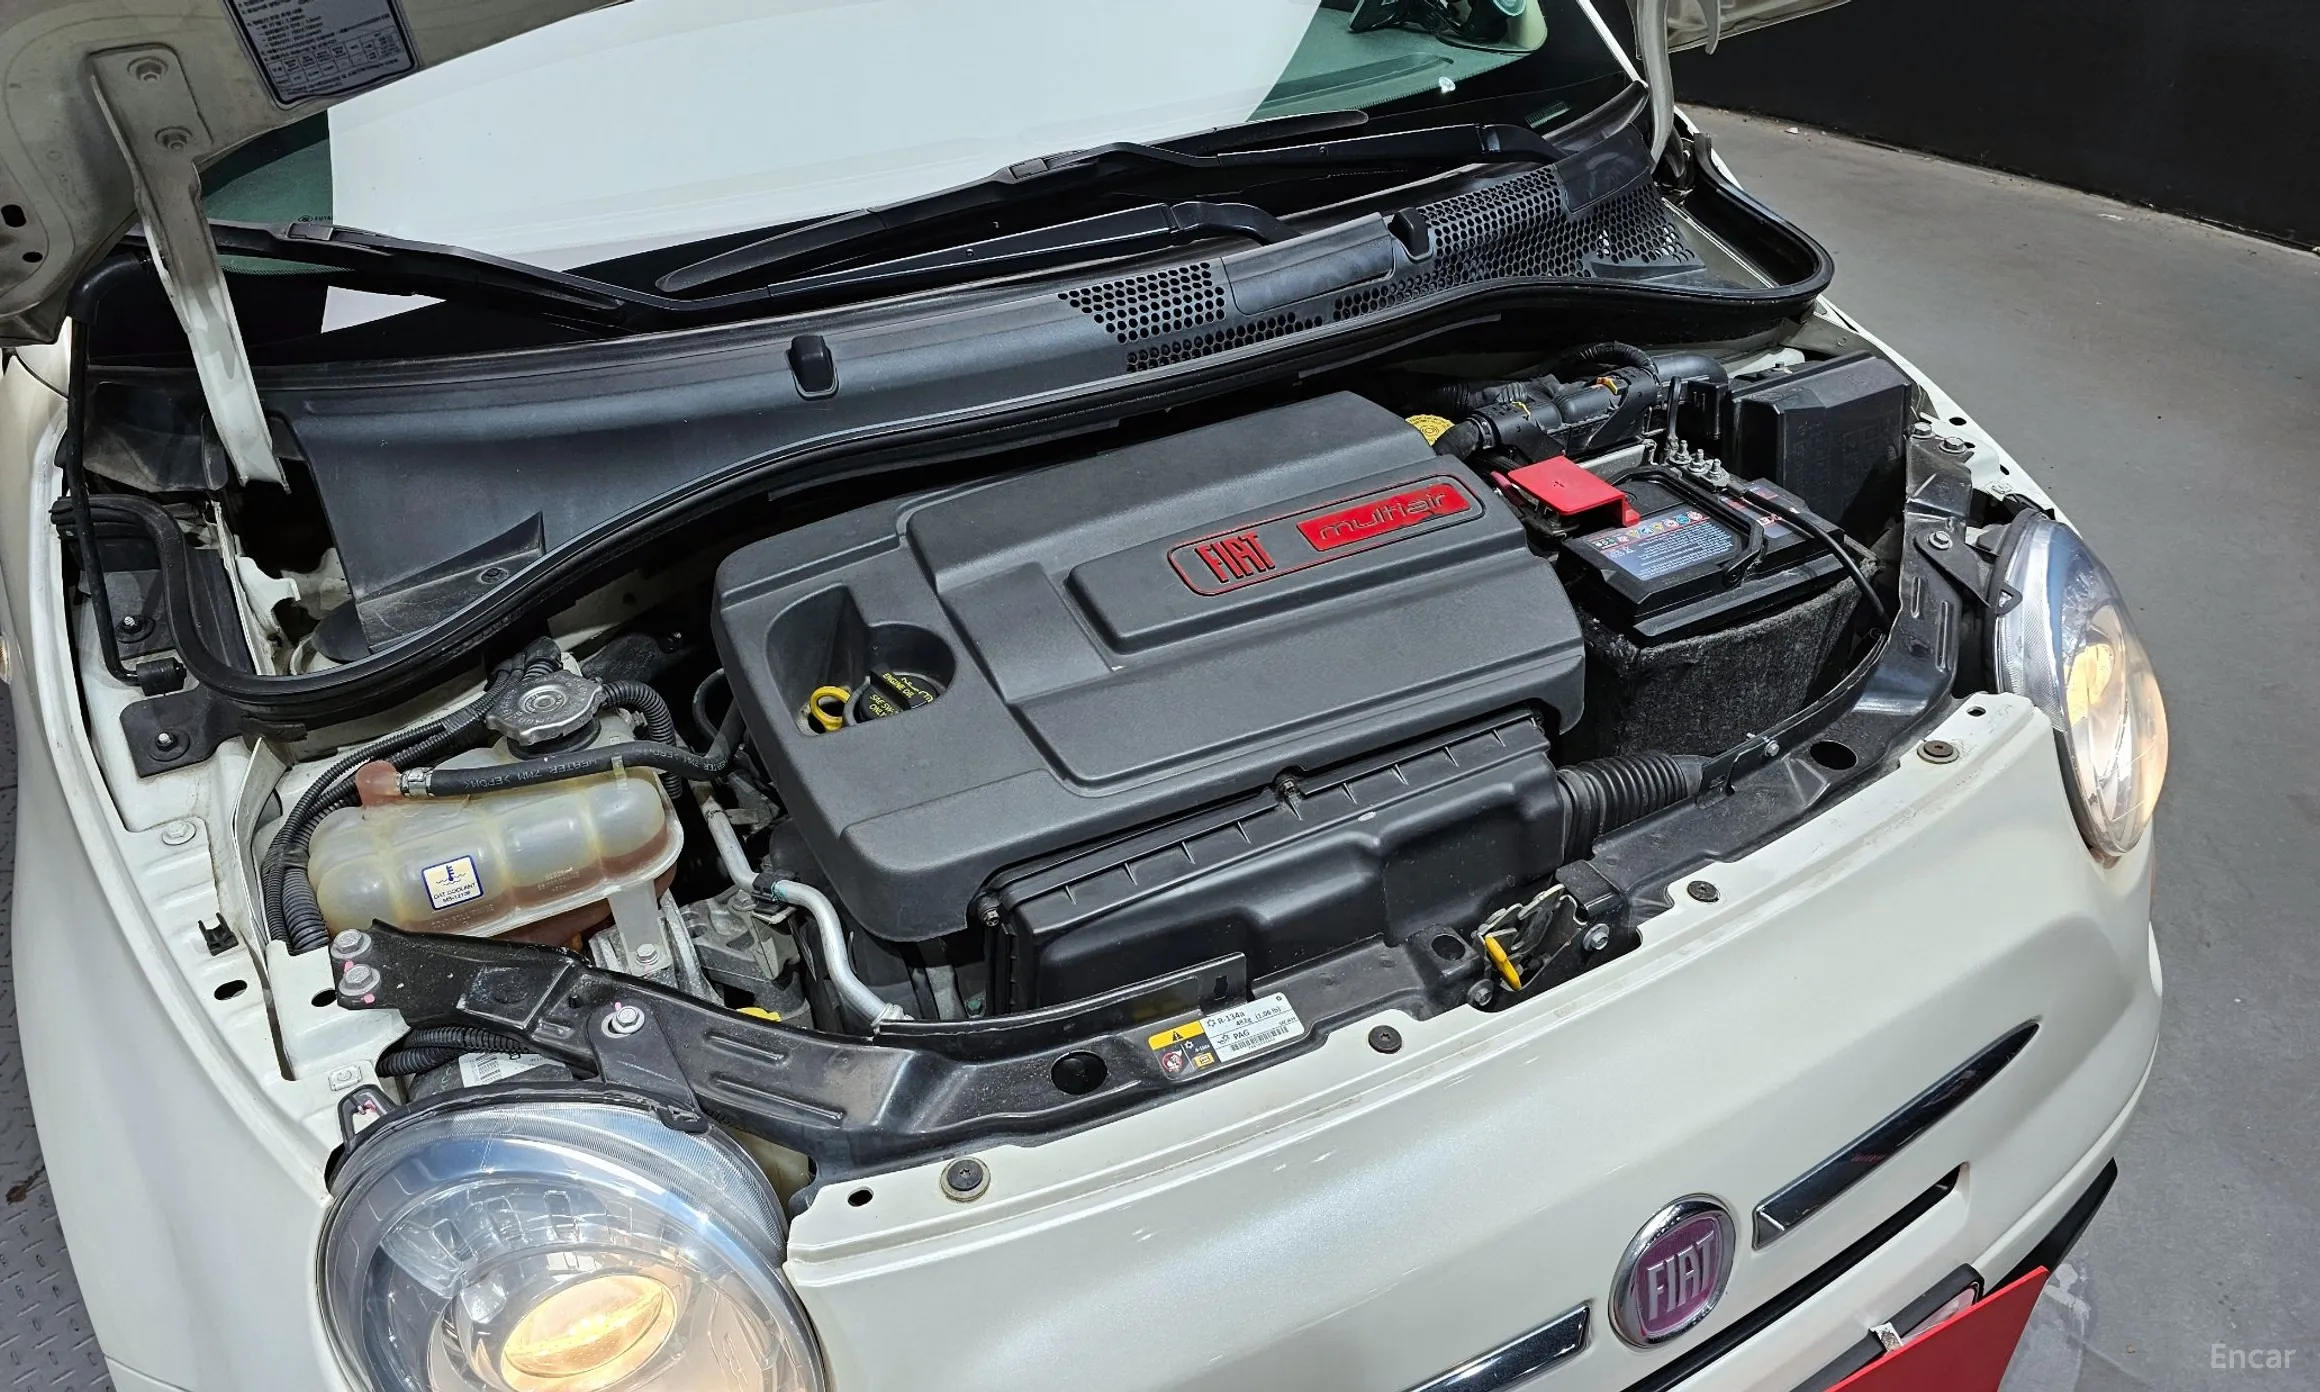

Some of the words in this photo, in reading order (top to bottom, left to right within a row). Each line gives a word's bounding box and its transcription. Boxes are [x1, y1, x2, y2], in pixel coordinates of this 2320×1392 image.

[1318, 488, 1447, 541] multiair
[1194, 531, 1276, 583] FIAT
[883, 672, 905, 690] ENGINE
[902, 688, 914, 698] OIL
[1217, 1011, 1246, 1025] R-134a
[1233, 1028, 1250, 1040] PAG
[1647, 1230, 1715, 1321] FIAT
